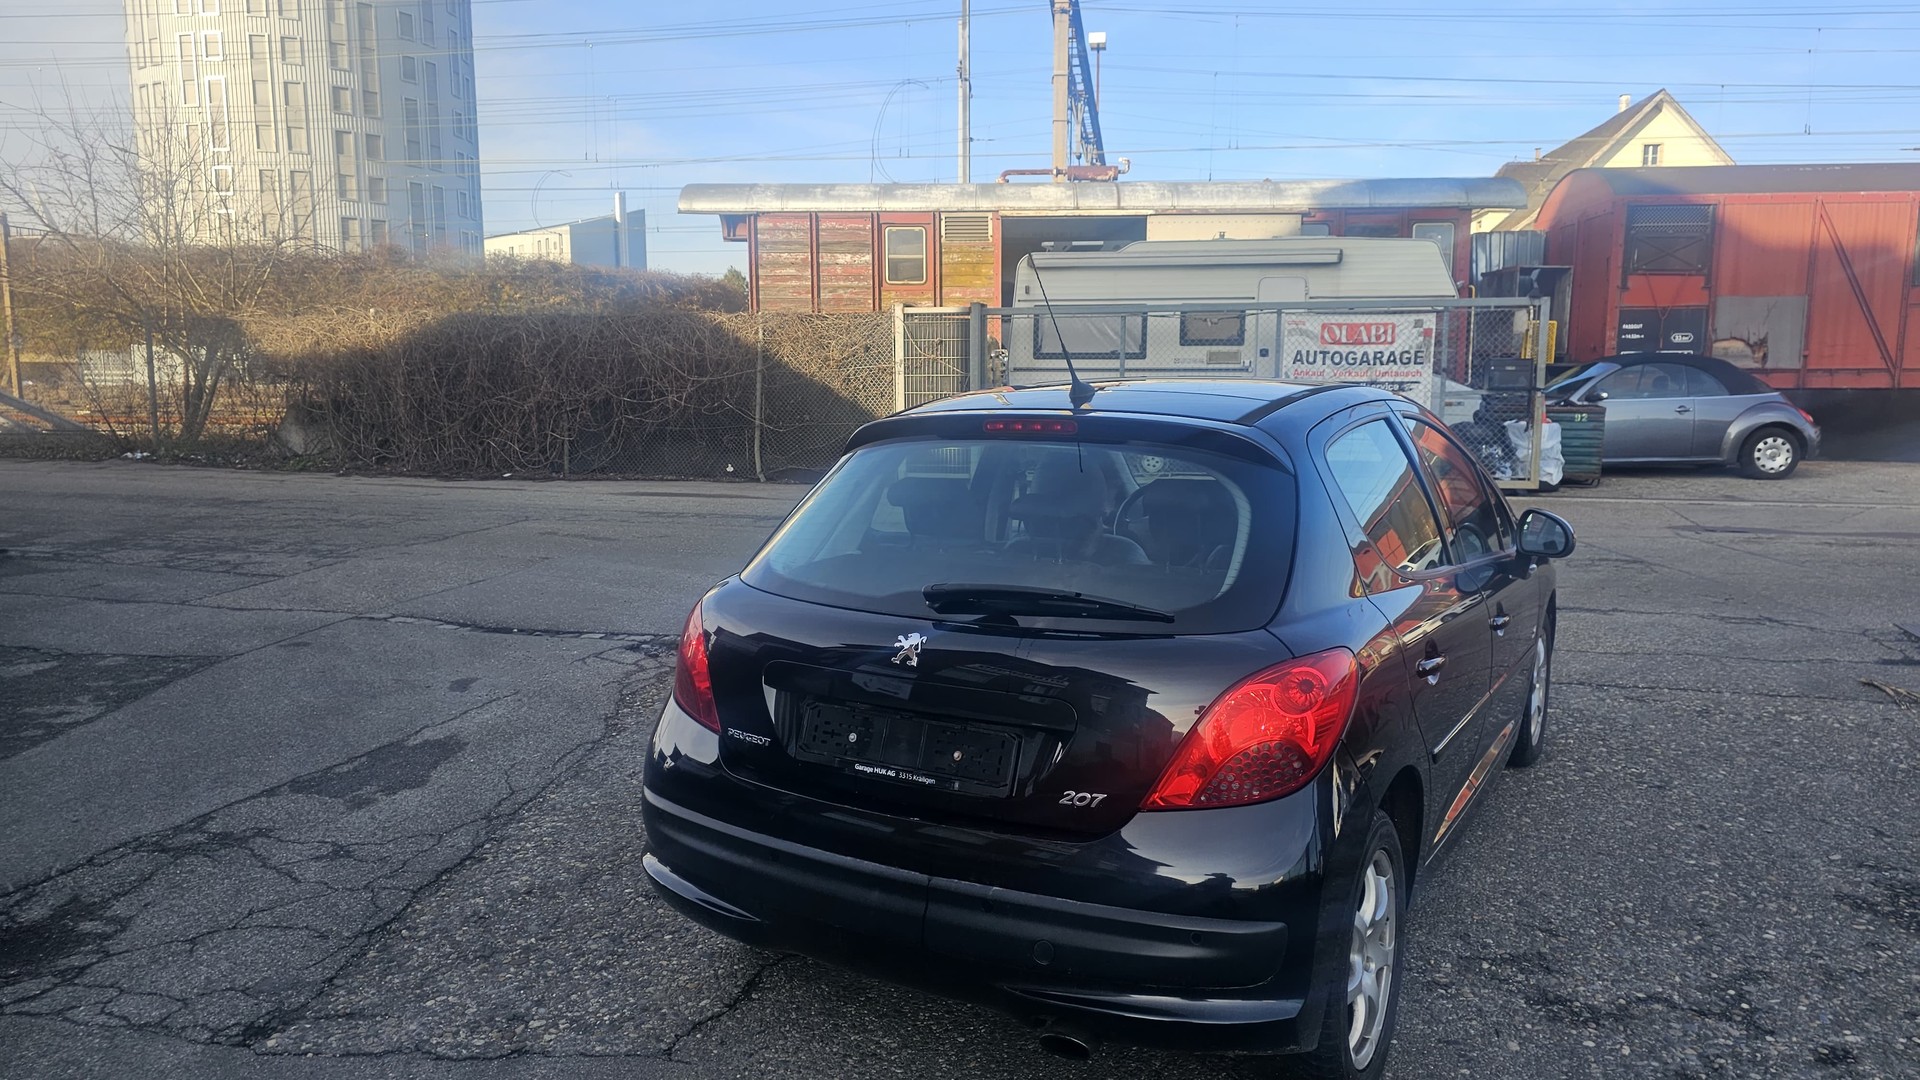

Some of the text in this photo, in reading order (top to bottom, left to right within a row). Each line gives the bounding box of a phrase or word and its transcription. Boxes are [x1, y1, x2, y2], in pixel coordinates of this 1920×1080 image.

[1323, 324, 1393, 344] OLABI
[1292, 350, 1425, 366] AUTOGARAGE
[1293, 368, 1423, 378] Ankauf Verkauf Umtausch
[727, 727, 771, 747] PEUGEOT
[854, 763, 874, 774] Garage
[873, 766, 887, 775] HUK
[886, 769, 896, 777] AG
[898, 771, 913, 780] 3315
[1058, 790, 1108, 808] 207
